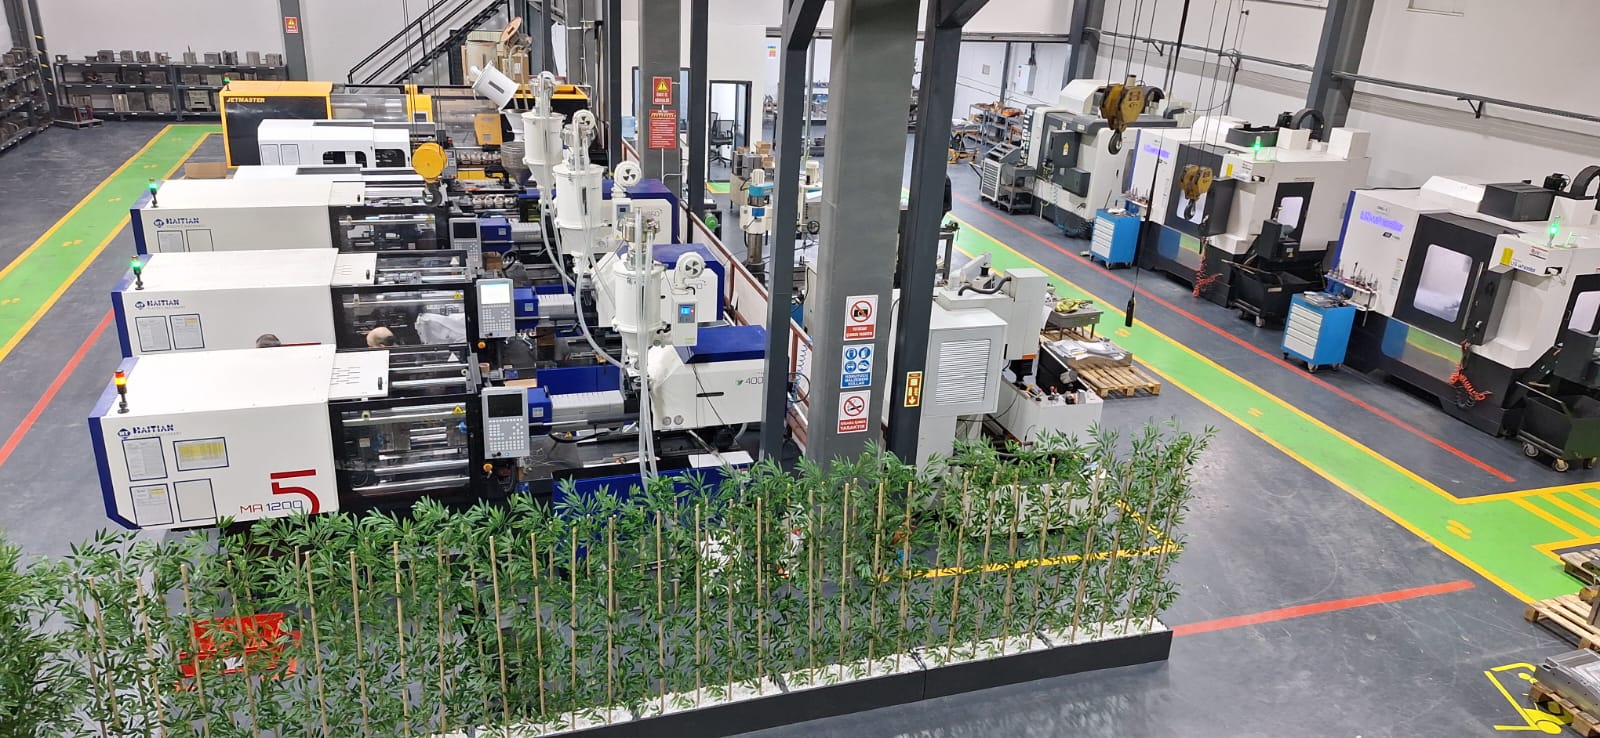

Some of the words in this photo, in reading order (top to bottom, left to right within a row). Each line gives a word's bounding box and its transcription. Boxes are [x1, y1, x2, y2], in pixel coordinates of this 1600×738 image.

[165, 217, 200, 225] HAITIAN
[146, 299, 180, 307] HAITIAN
[132, 424, 175, 435] HAITIAN
[270, 469, 320, 516] 5
[240, 504, 263, 514] MA
[266, 500, 303, 512] 1200
